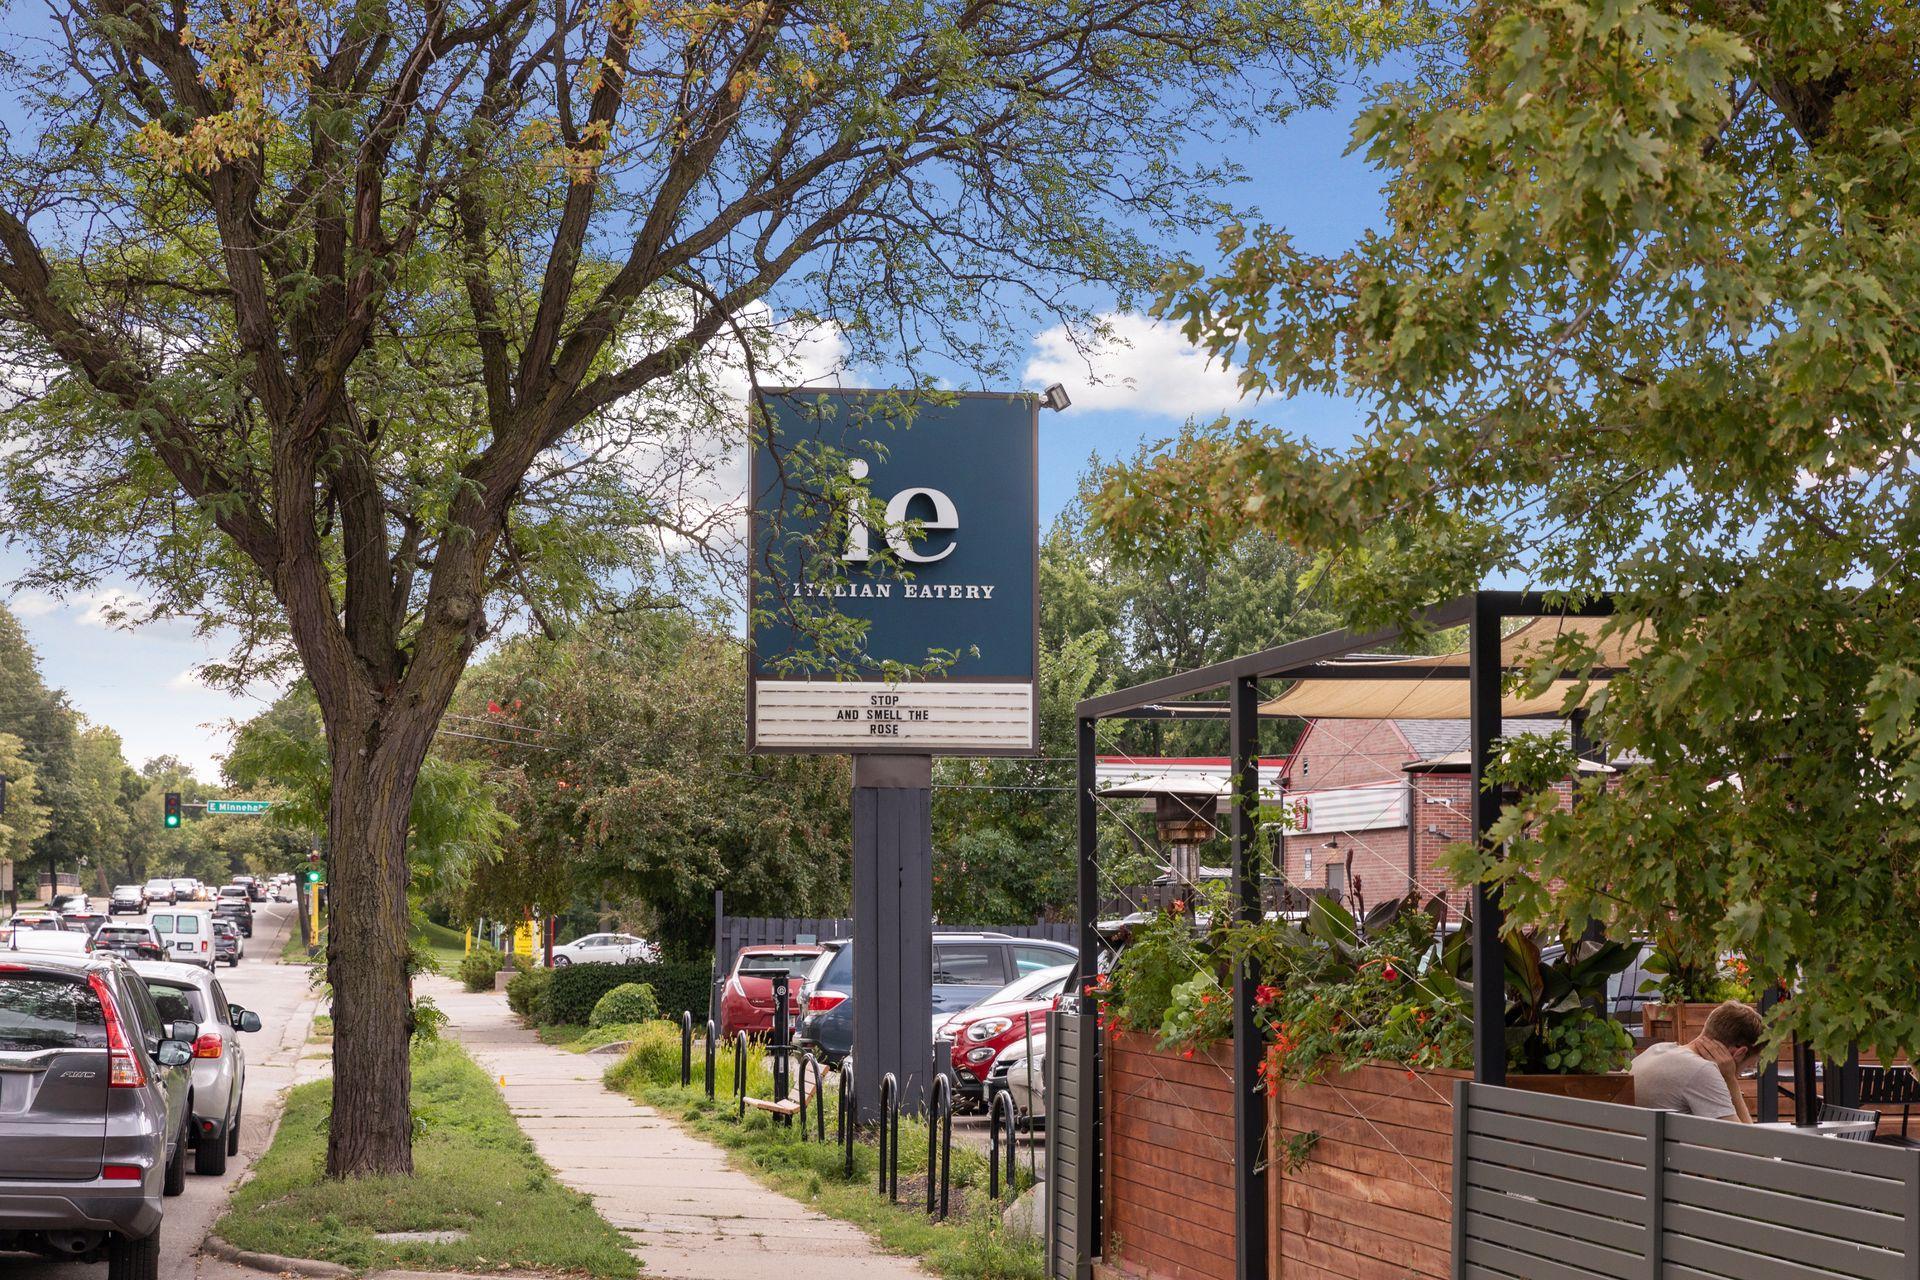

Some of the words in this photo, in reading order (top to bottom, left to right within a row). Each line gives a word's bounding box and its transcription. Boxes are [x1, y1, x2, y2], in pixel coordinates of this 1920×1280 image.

[842, 459, 959, 563] ie
[793, 583, 891, 599] ITALIAN
[904, 583, 995, 600] EATERY
[871, 695, 899, 706] STOP
[836, 708, 859, 720] AND
[867, 708, 903, 720] SMELL
[908, 710, 929, 721] THE
[870, 723, 899, 735] ROSE
[210, 803, 216, 811] E
